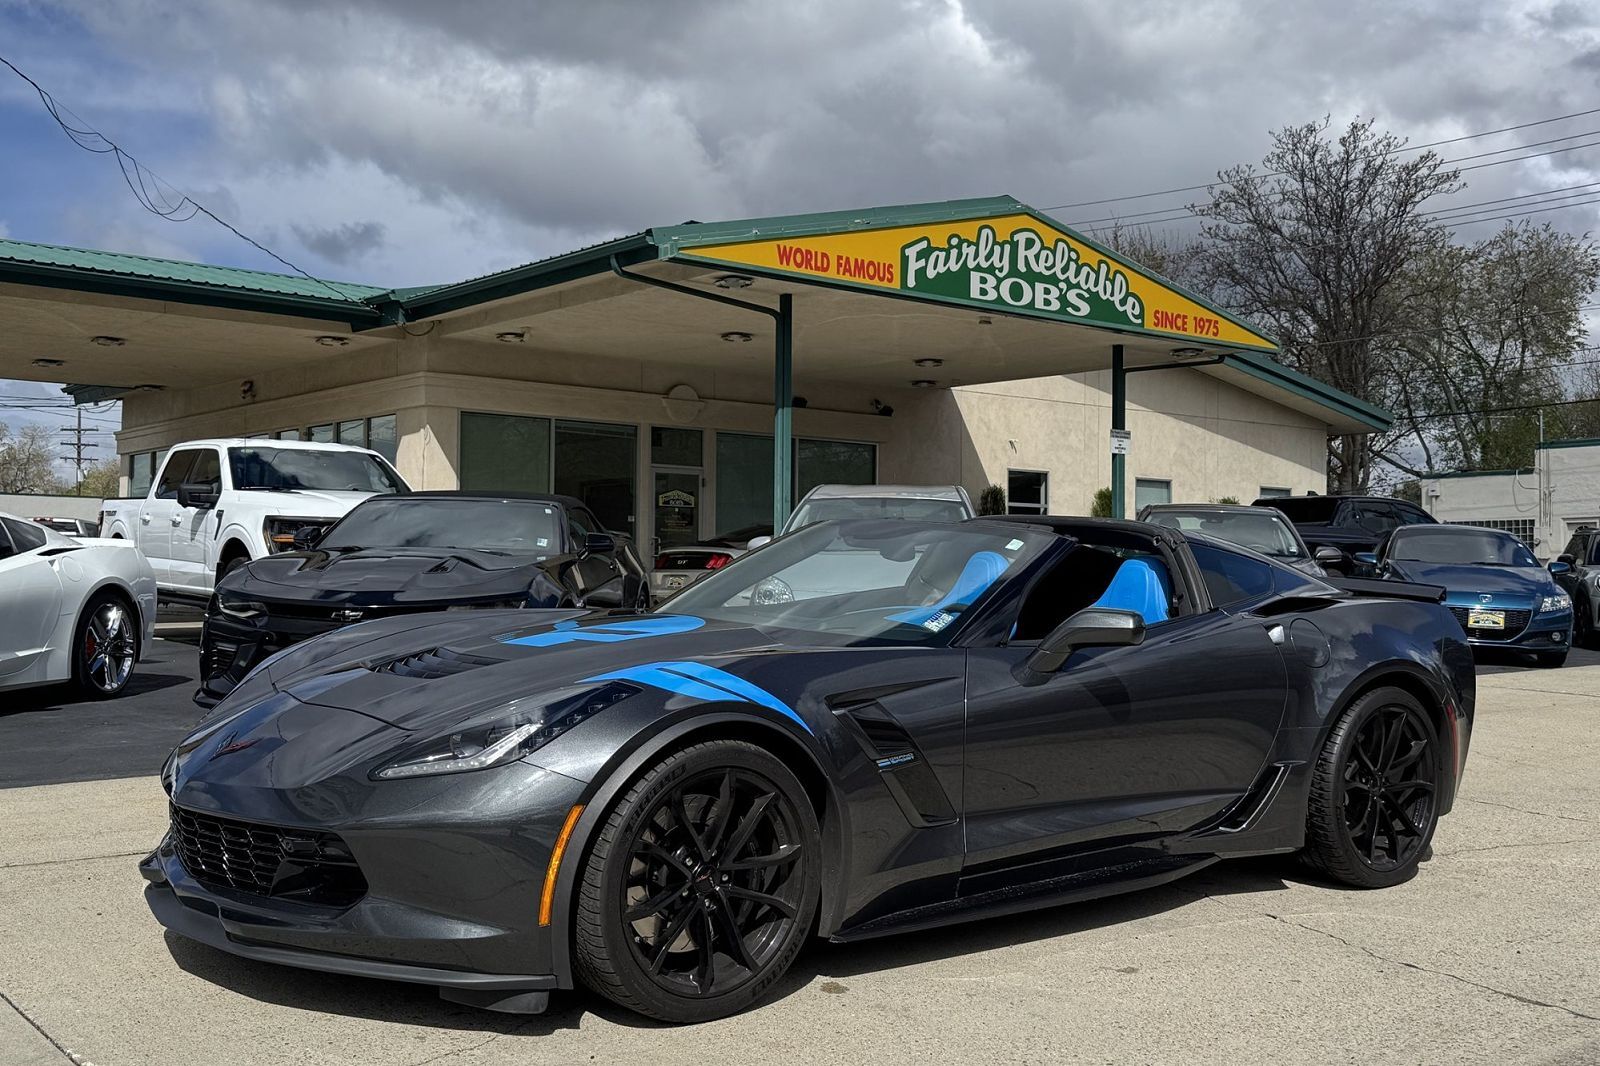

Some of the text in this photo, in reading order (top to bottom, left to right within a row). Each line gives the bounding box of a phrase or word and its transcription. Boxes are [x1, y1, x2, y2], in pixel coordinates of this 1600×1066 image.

[776, 244, 894, 283] WORLD FAMOUS
[905, 228, 1142, 323] Fairly Reliable
[969, 270, 1091, 317] BOB'S
[1153, 309, 1219, 337] SINCE 1975
